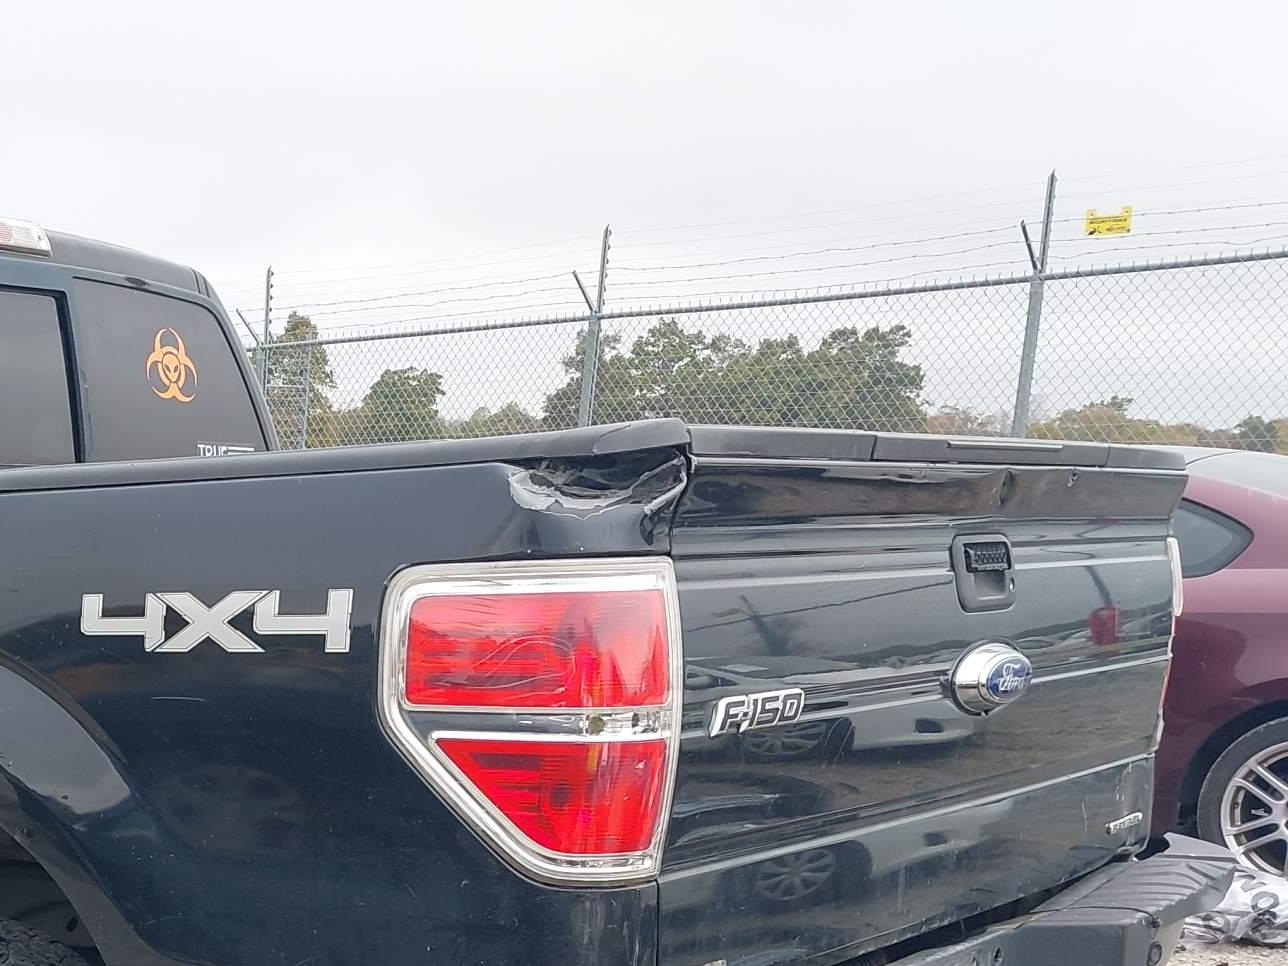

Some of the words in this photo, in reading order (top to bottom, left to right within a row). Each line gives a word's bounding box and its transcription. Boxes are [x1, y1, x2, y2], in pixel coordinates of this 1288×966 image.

[80, 588, 354, 653] 4X4
[998, 663, 1031, 692] Ford
[709, 688, 805, 737] F-150
